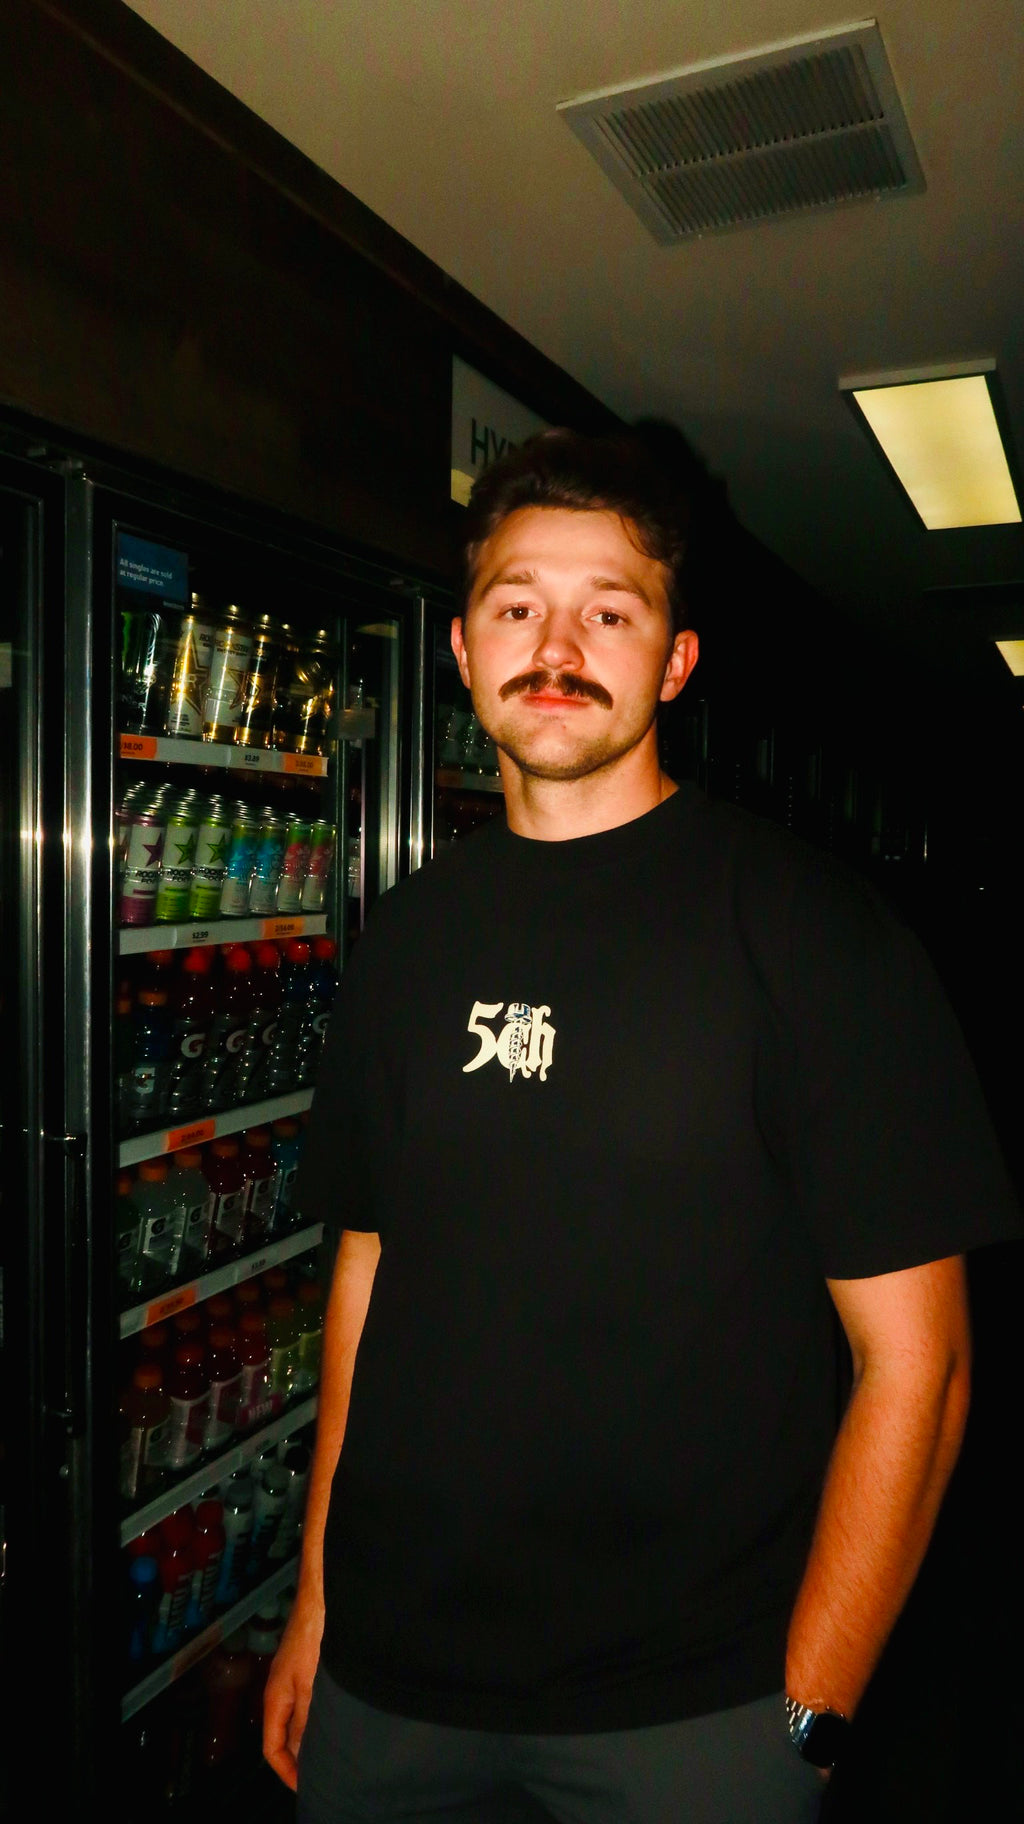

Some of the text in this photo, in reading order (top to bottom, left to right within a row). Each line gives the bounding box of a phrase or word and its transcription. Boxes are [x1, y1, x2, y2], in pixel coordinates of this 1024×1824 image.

[119, 557, 173, 580] All singles are sold
[119, 568, 126, 577] at
[127, 571, 148, 582] regular
[180, 1033, 206, 1058] G
[225, 1029, 248, 1053] G
[190, 1205, 203, 1224] G
[150, 1216, 167, 1236] G
